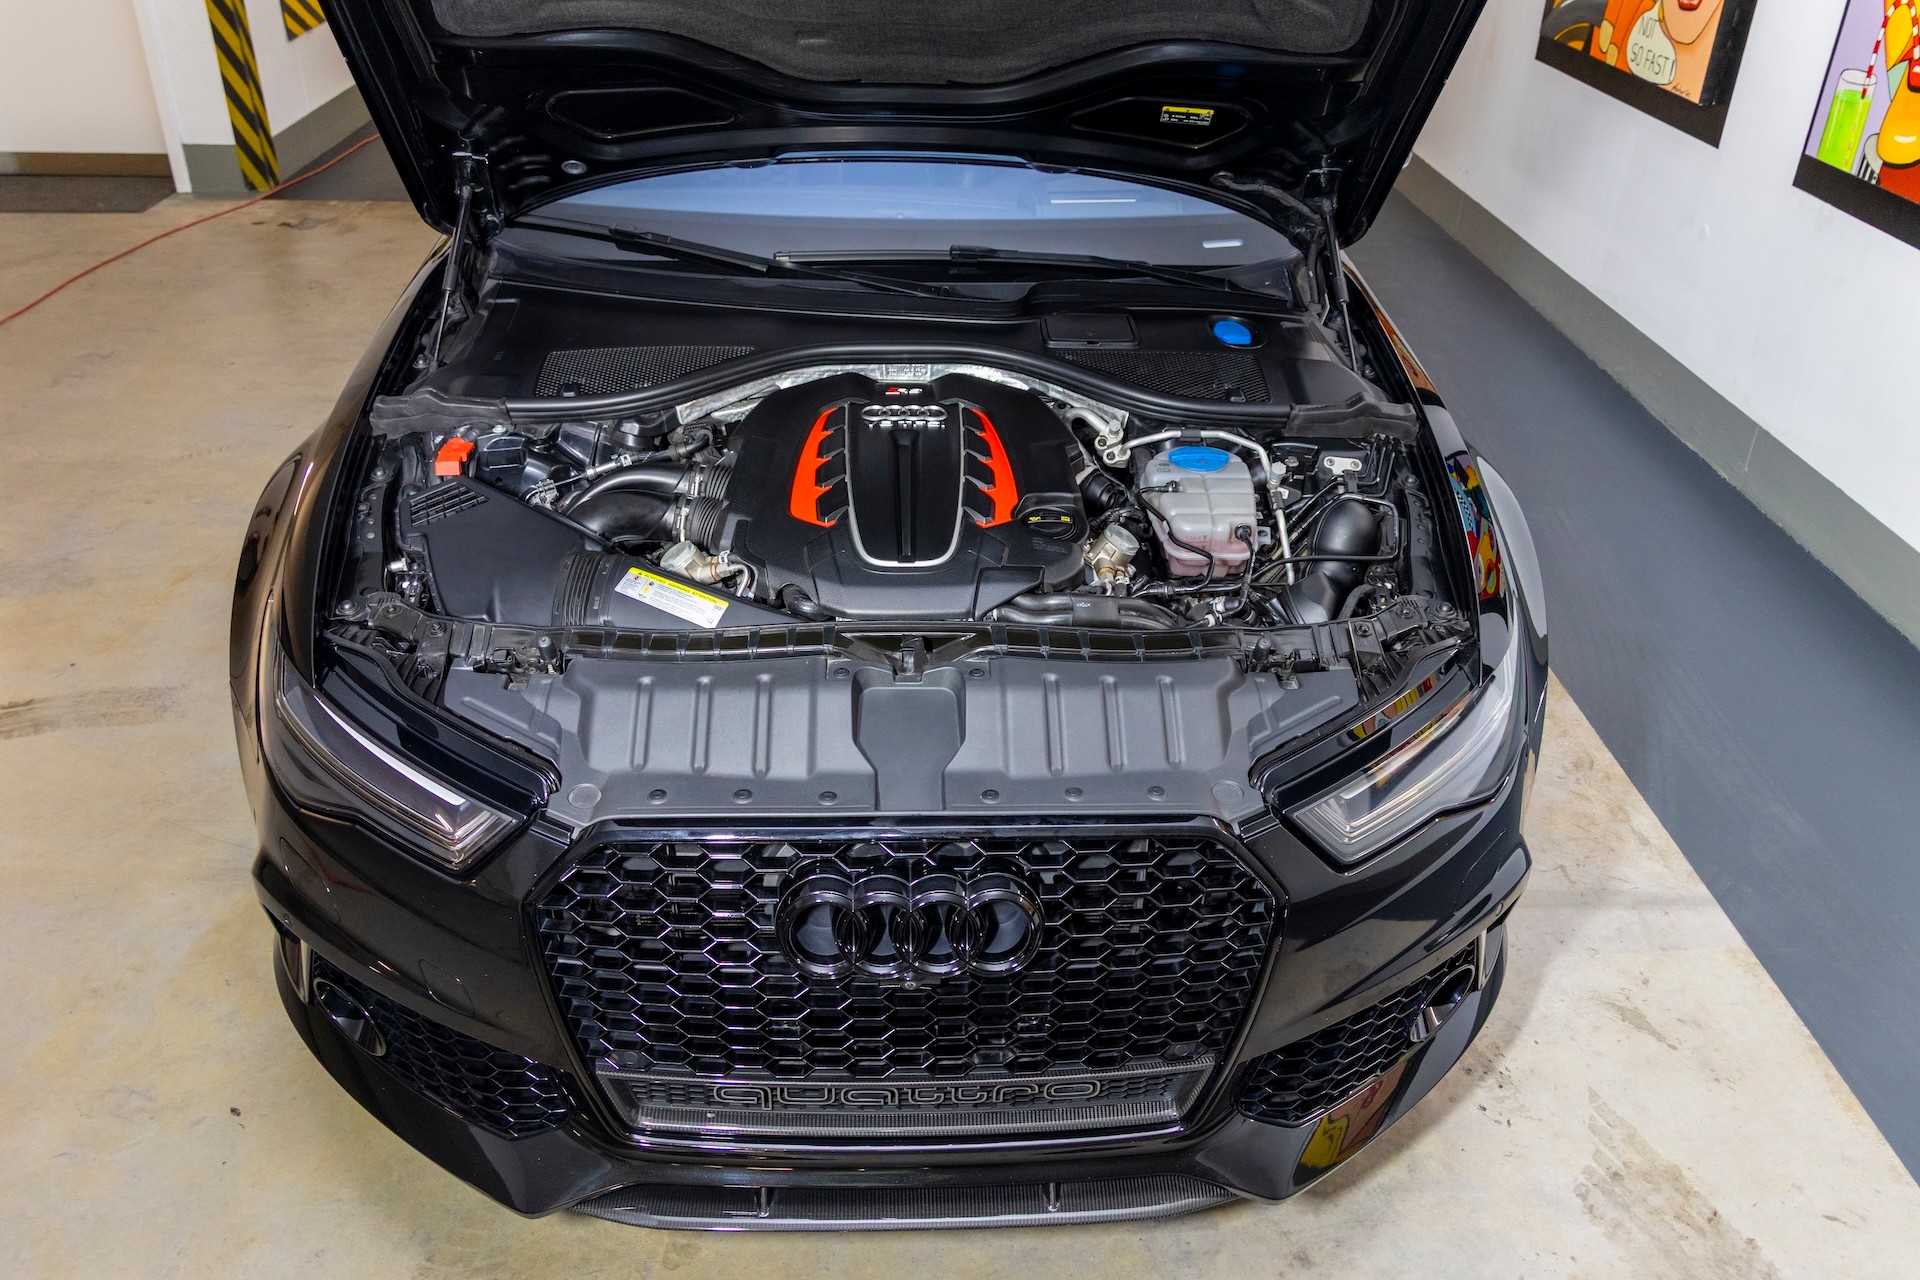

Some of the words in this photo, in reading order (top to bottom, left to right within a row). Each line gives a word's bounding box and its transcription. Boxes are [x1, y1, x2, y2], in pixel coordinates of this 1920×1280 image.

[1638, 15, 1659, 39] NOT
[1630, 42, 1644, 67] SO
[644, 573, 667, 585] ACHTUNG
[667, 582, 691, 594] WARNING
[692, 590, 718, 604] ATTENTION
[713, 1081, 1101, 1111] quattro
